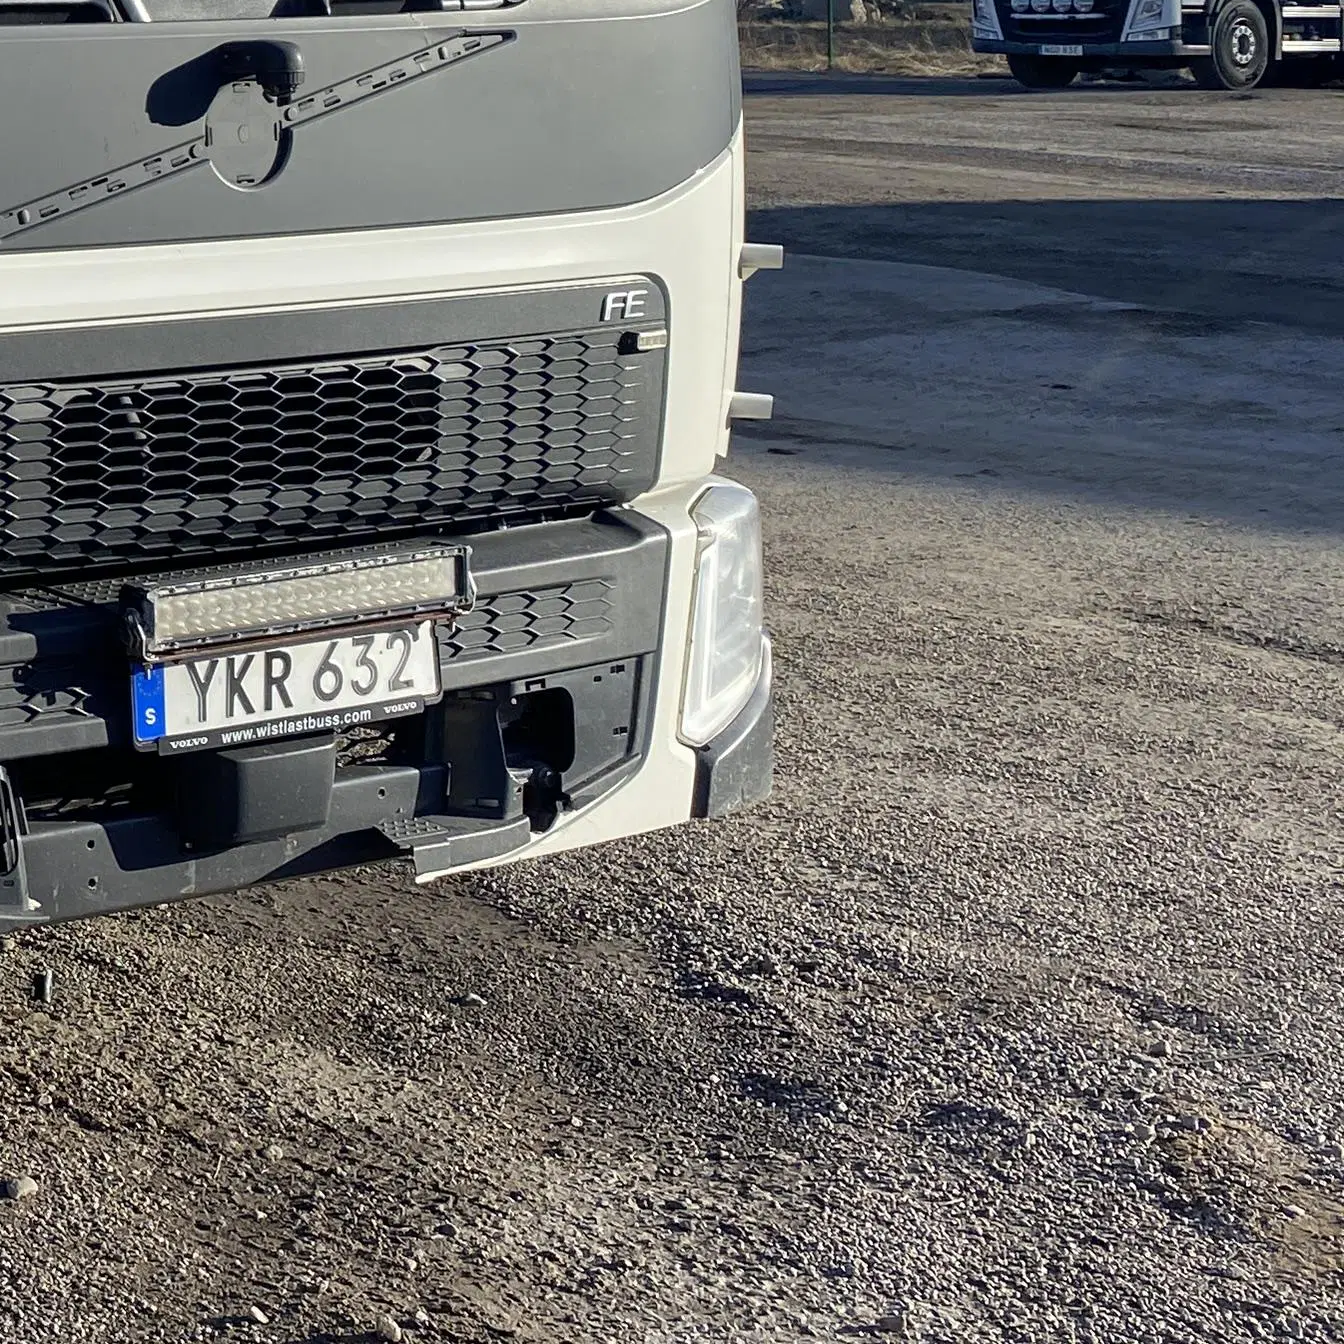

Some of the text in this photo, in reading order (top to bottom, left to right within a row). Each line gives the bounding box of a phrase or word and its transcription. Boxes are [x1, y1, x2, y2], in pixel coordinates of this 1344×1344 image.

[604, 290, 648, 320] FE
[185, 630, 415, 723] YKR 632
[145, 708, 157, 725] S
[170, 701, 417, 749] VOLVO www.wistlastbuss.com VOLVO
